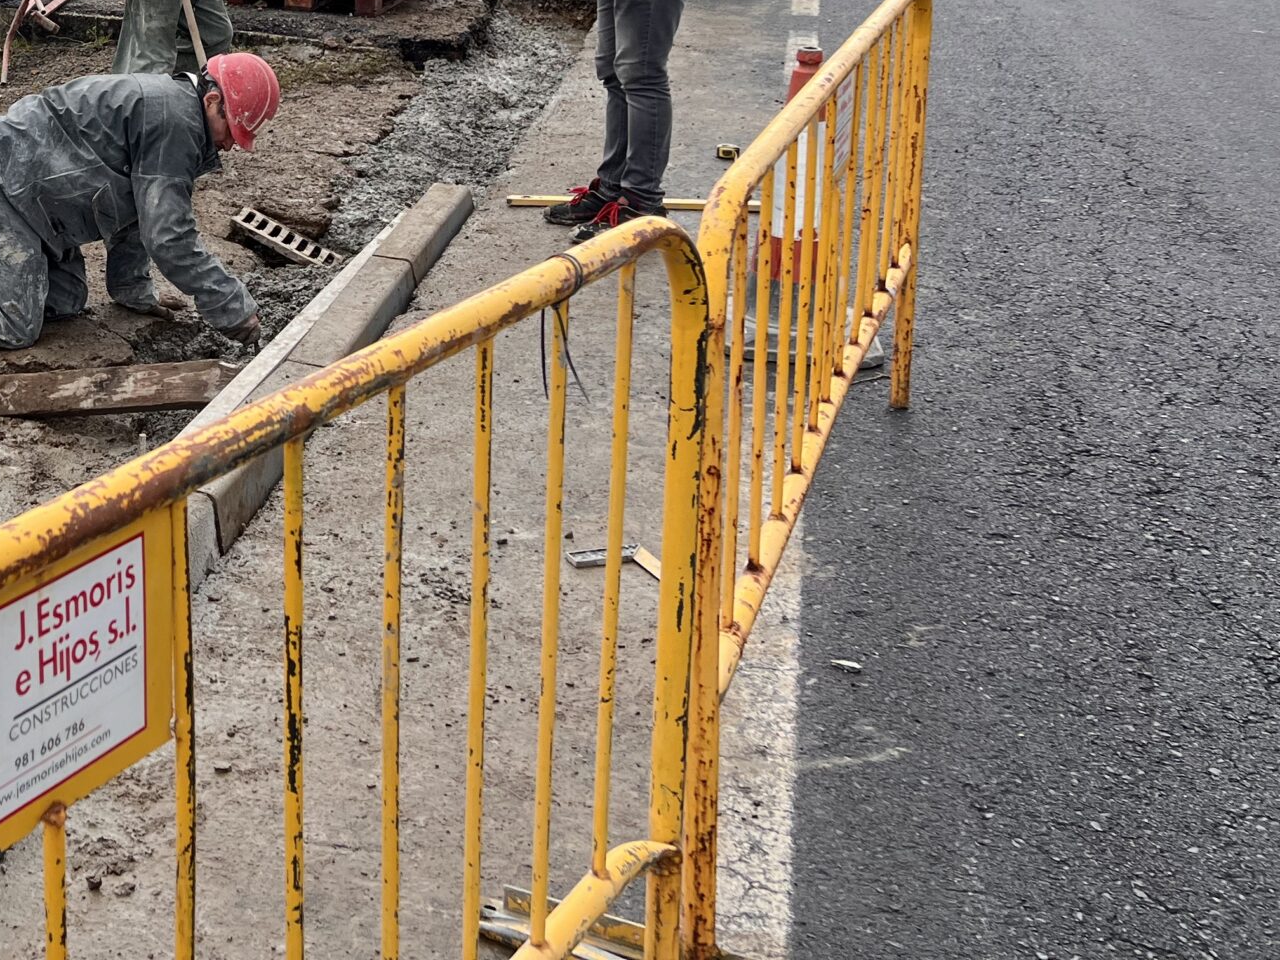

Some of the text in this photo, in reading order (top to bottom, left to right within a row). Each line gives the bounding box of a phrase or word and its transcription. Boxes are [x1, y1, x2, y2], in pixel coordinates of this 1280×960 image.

[15, 669, 32, 696] e
[108, 595, 137, 644] s.l.
[8, 652, 138, 742] CONSTRUCCIONES
[14, 717, 86, 772] 981 606 786
